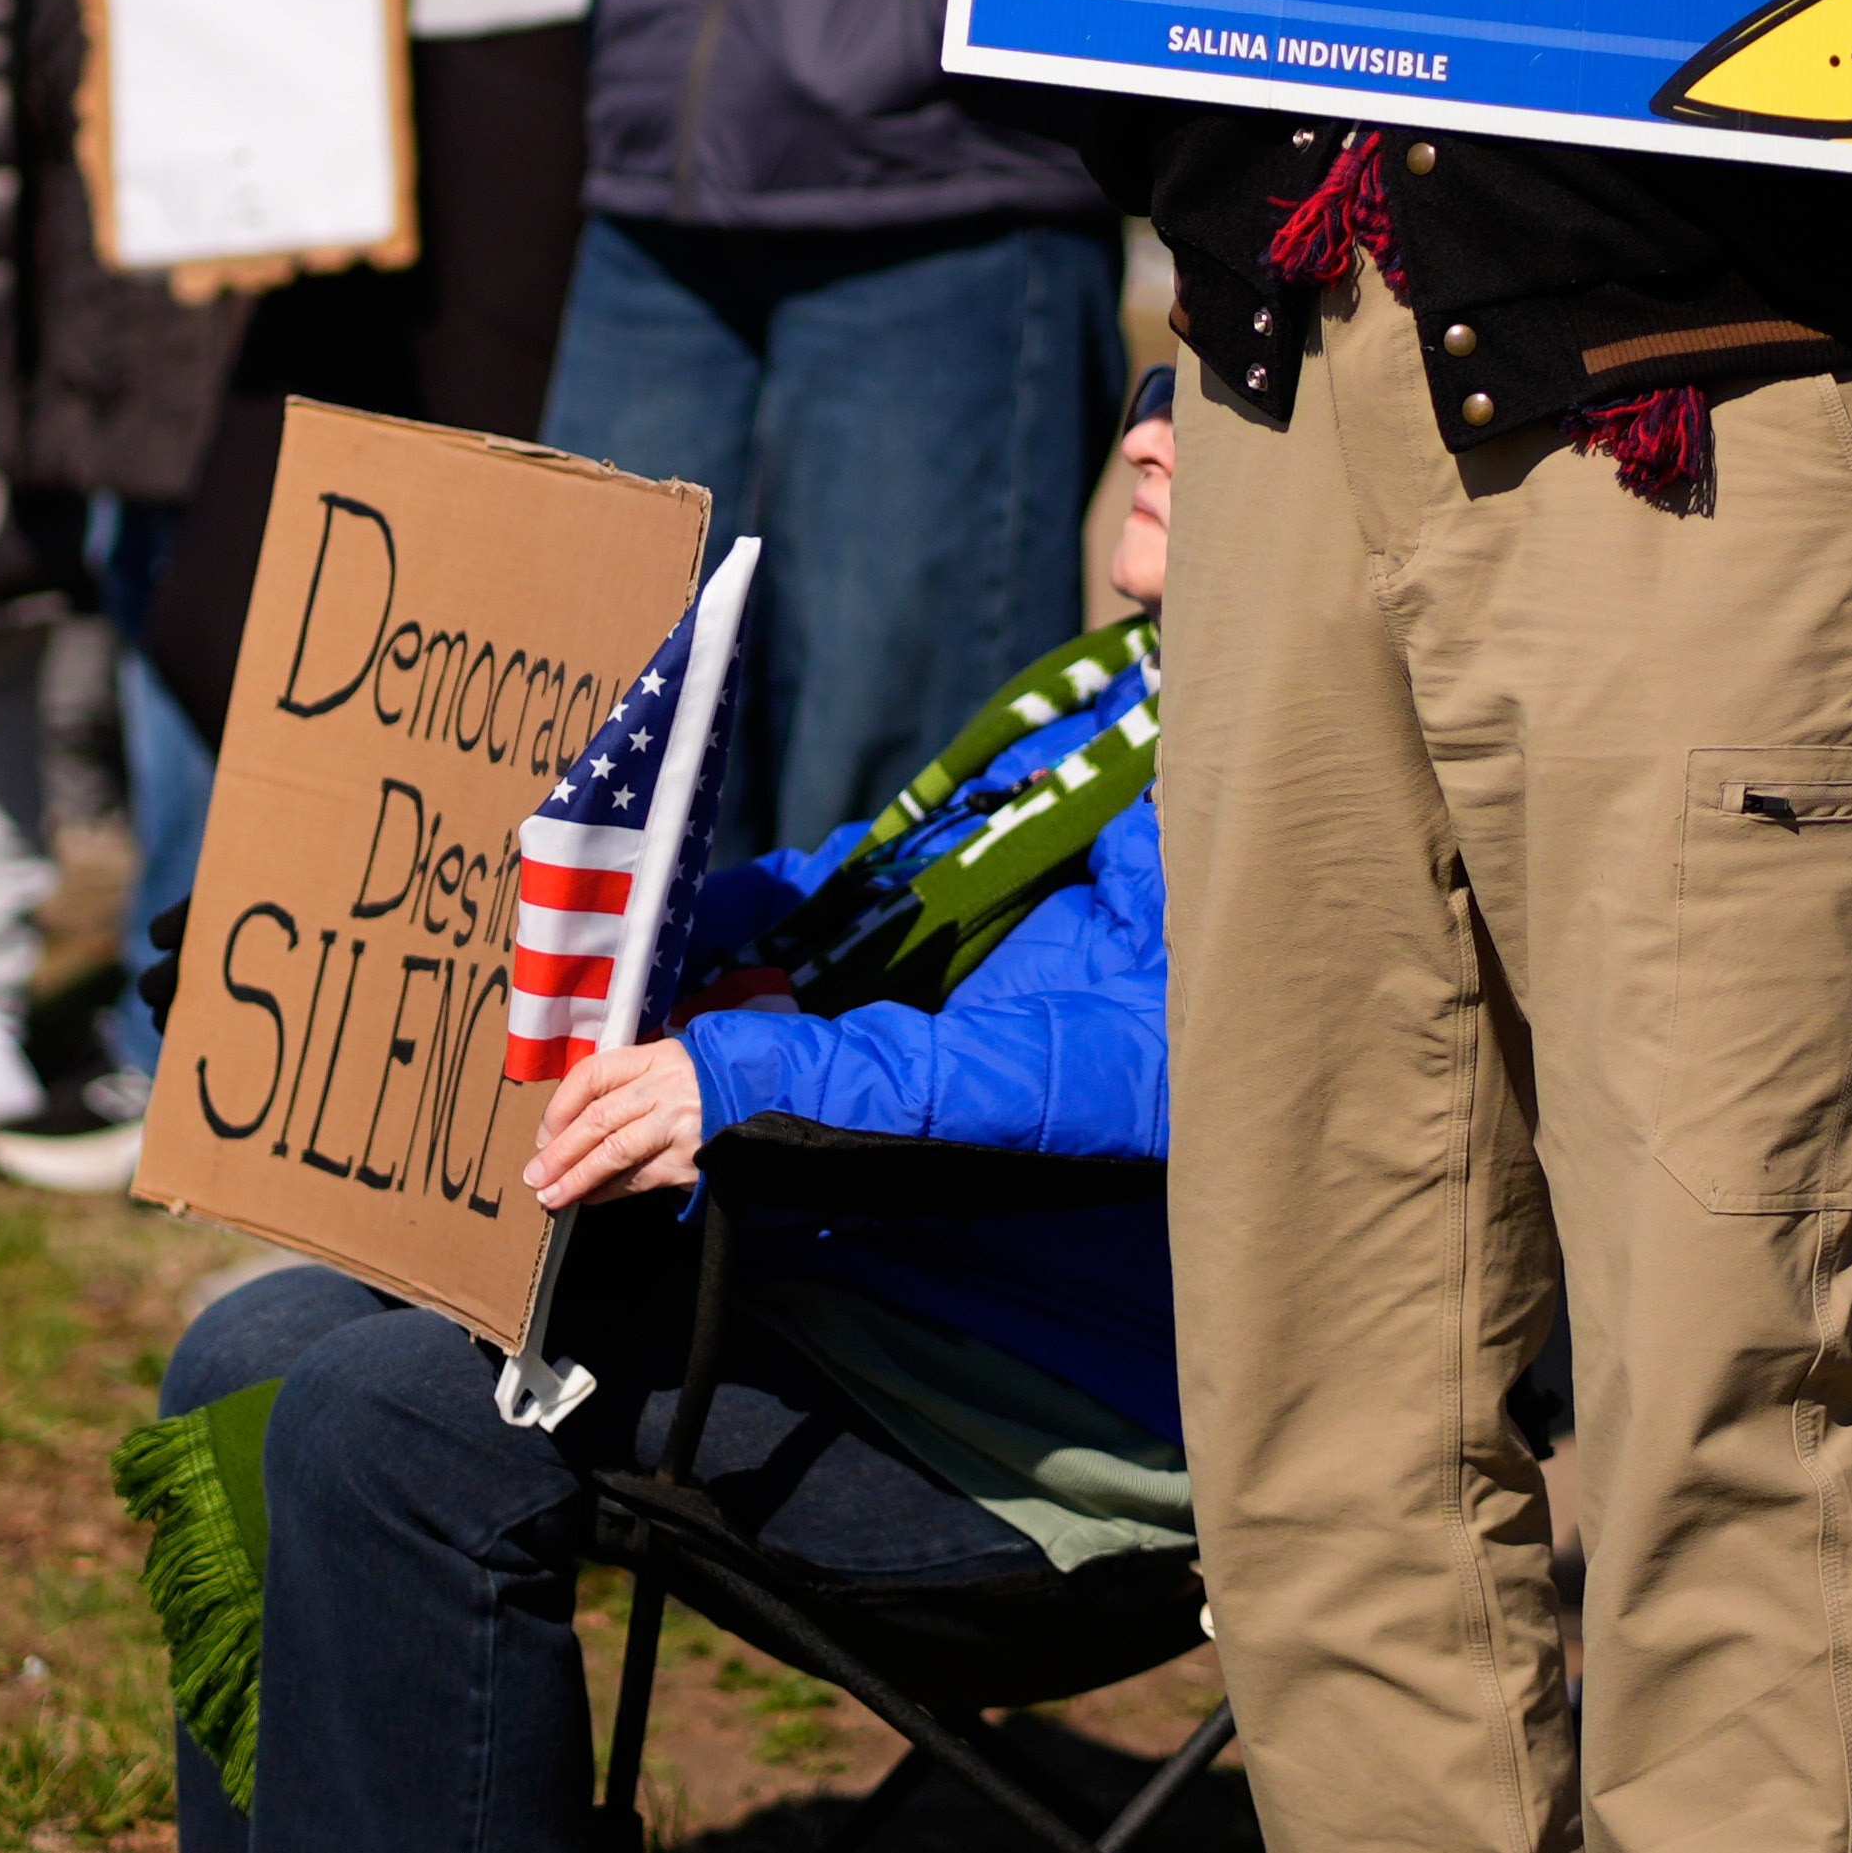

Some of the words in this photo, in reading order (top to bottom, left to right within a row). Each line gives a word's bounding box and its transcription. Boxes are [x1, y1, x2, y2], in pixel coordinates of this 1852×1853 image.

[1168, 25, 1268, 62] SALINA
[1277, 36, 1449, 82] INDIVISIBLE
[350, 776, 488, 948] Dies
[196, 900, 524, 1220] SILENCE
